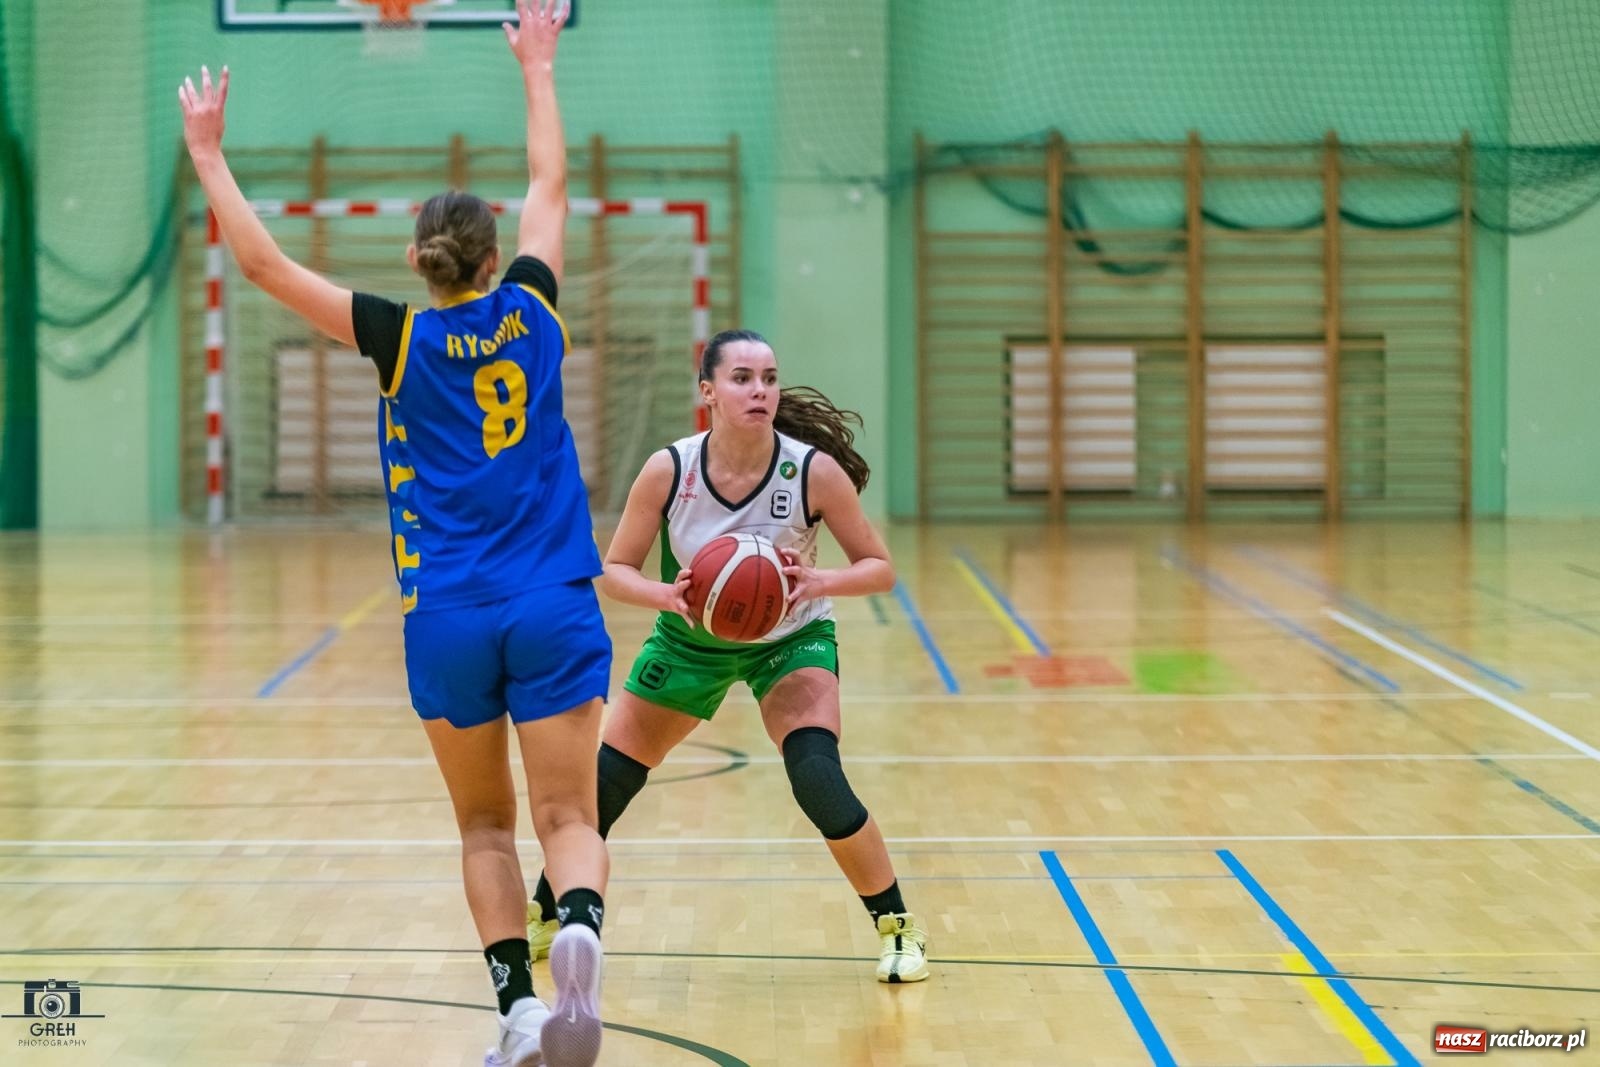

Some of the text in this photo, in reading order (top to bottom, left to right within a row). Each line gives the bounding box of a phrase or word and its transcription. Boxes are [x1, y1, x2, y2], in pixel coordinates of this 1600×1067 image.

[473, 359, 528, 460] 8
[770, 490, 792, 519] 8
[638, 658, 672, 690] 8
